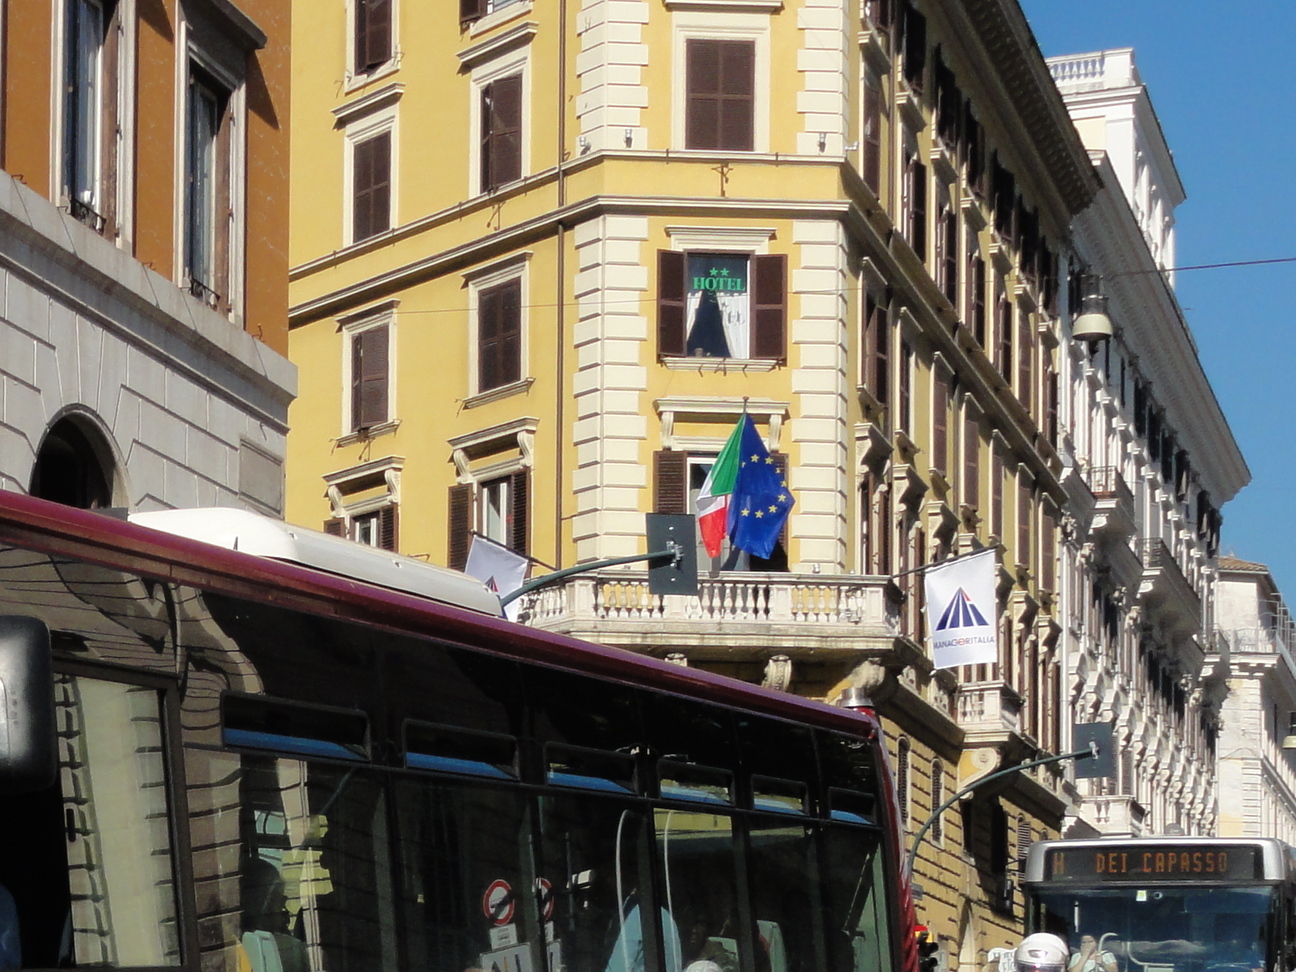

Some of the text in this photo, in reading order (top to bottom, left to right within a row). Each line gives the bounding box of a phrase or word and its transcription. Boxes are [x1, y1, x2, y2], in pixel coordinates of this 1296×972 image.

[692, 276, 746, 292] HOTEL
[1095, 852, 1128, 874] DEI
[1141, 851, 1228, 874] CAPASSO
